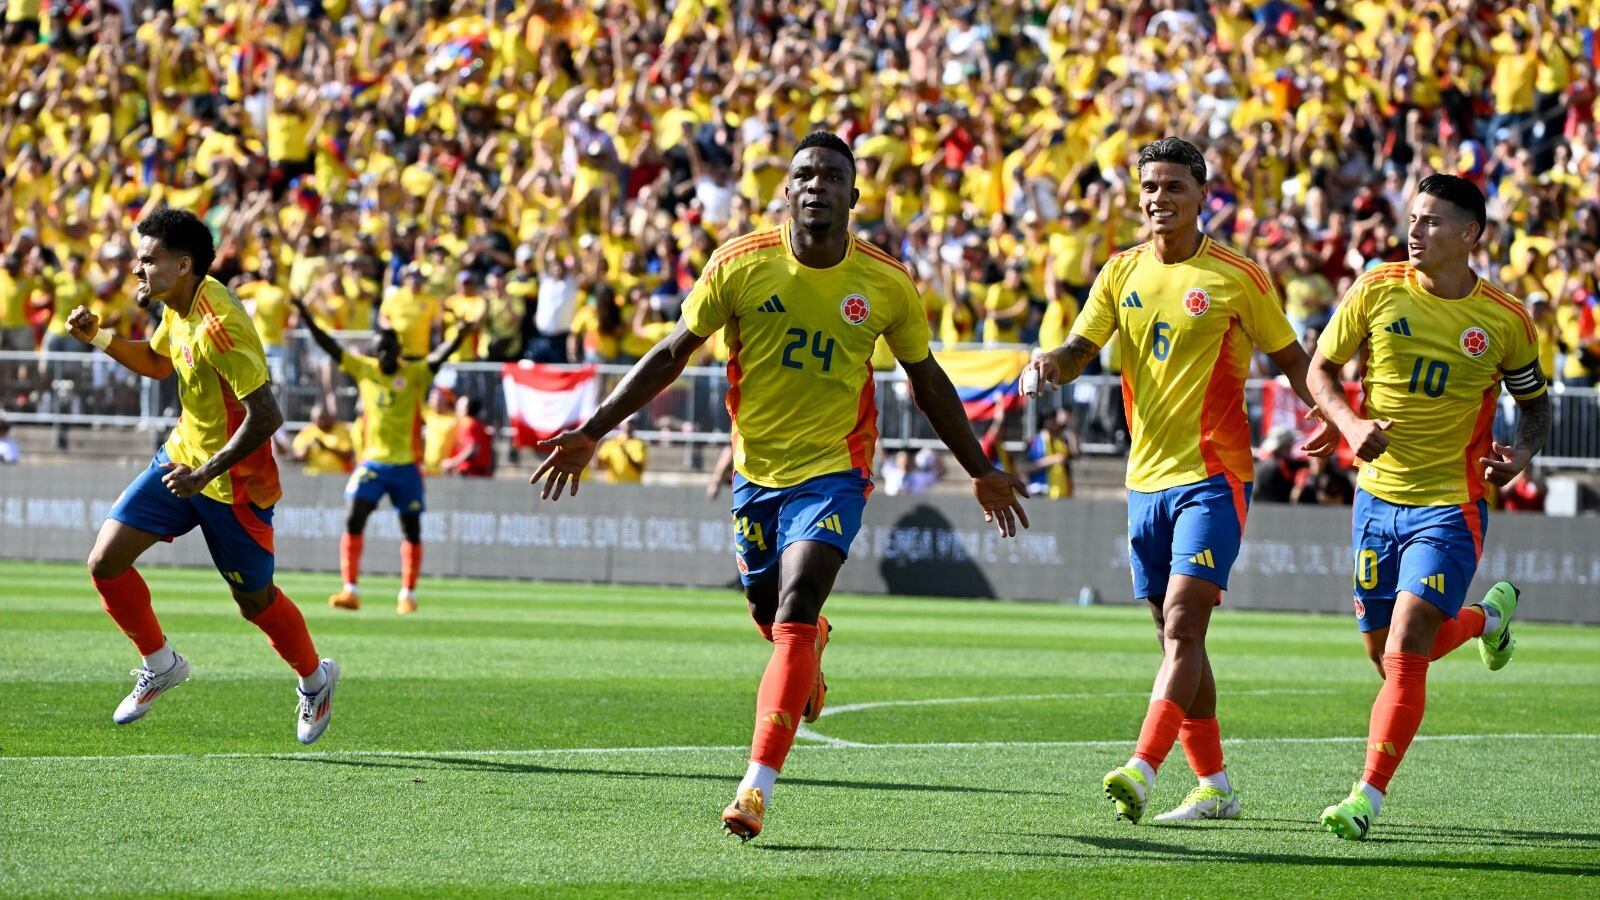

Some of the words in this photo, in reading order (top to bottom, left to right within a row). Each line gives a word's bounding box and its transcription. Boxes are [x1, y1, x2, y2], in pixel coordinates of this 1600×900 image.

[782, 328, 834, 371] 24
[1153, 321, 1171, 361] 6
[1408, 356, 1450, 398] 10
[1353, 549, 1378, 590] 0
